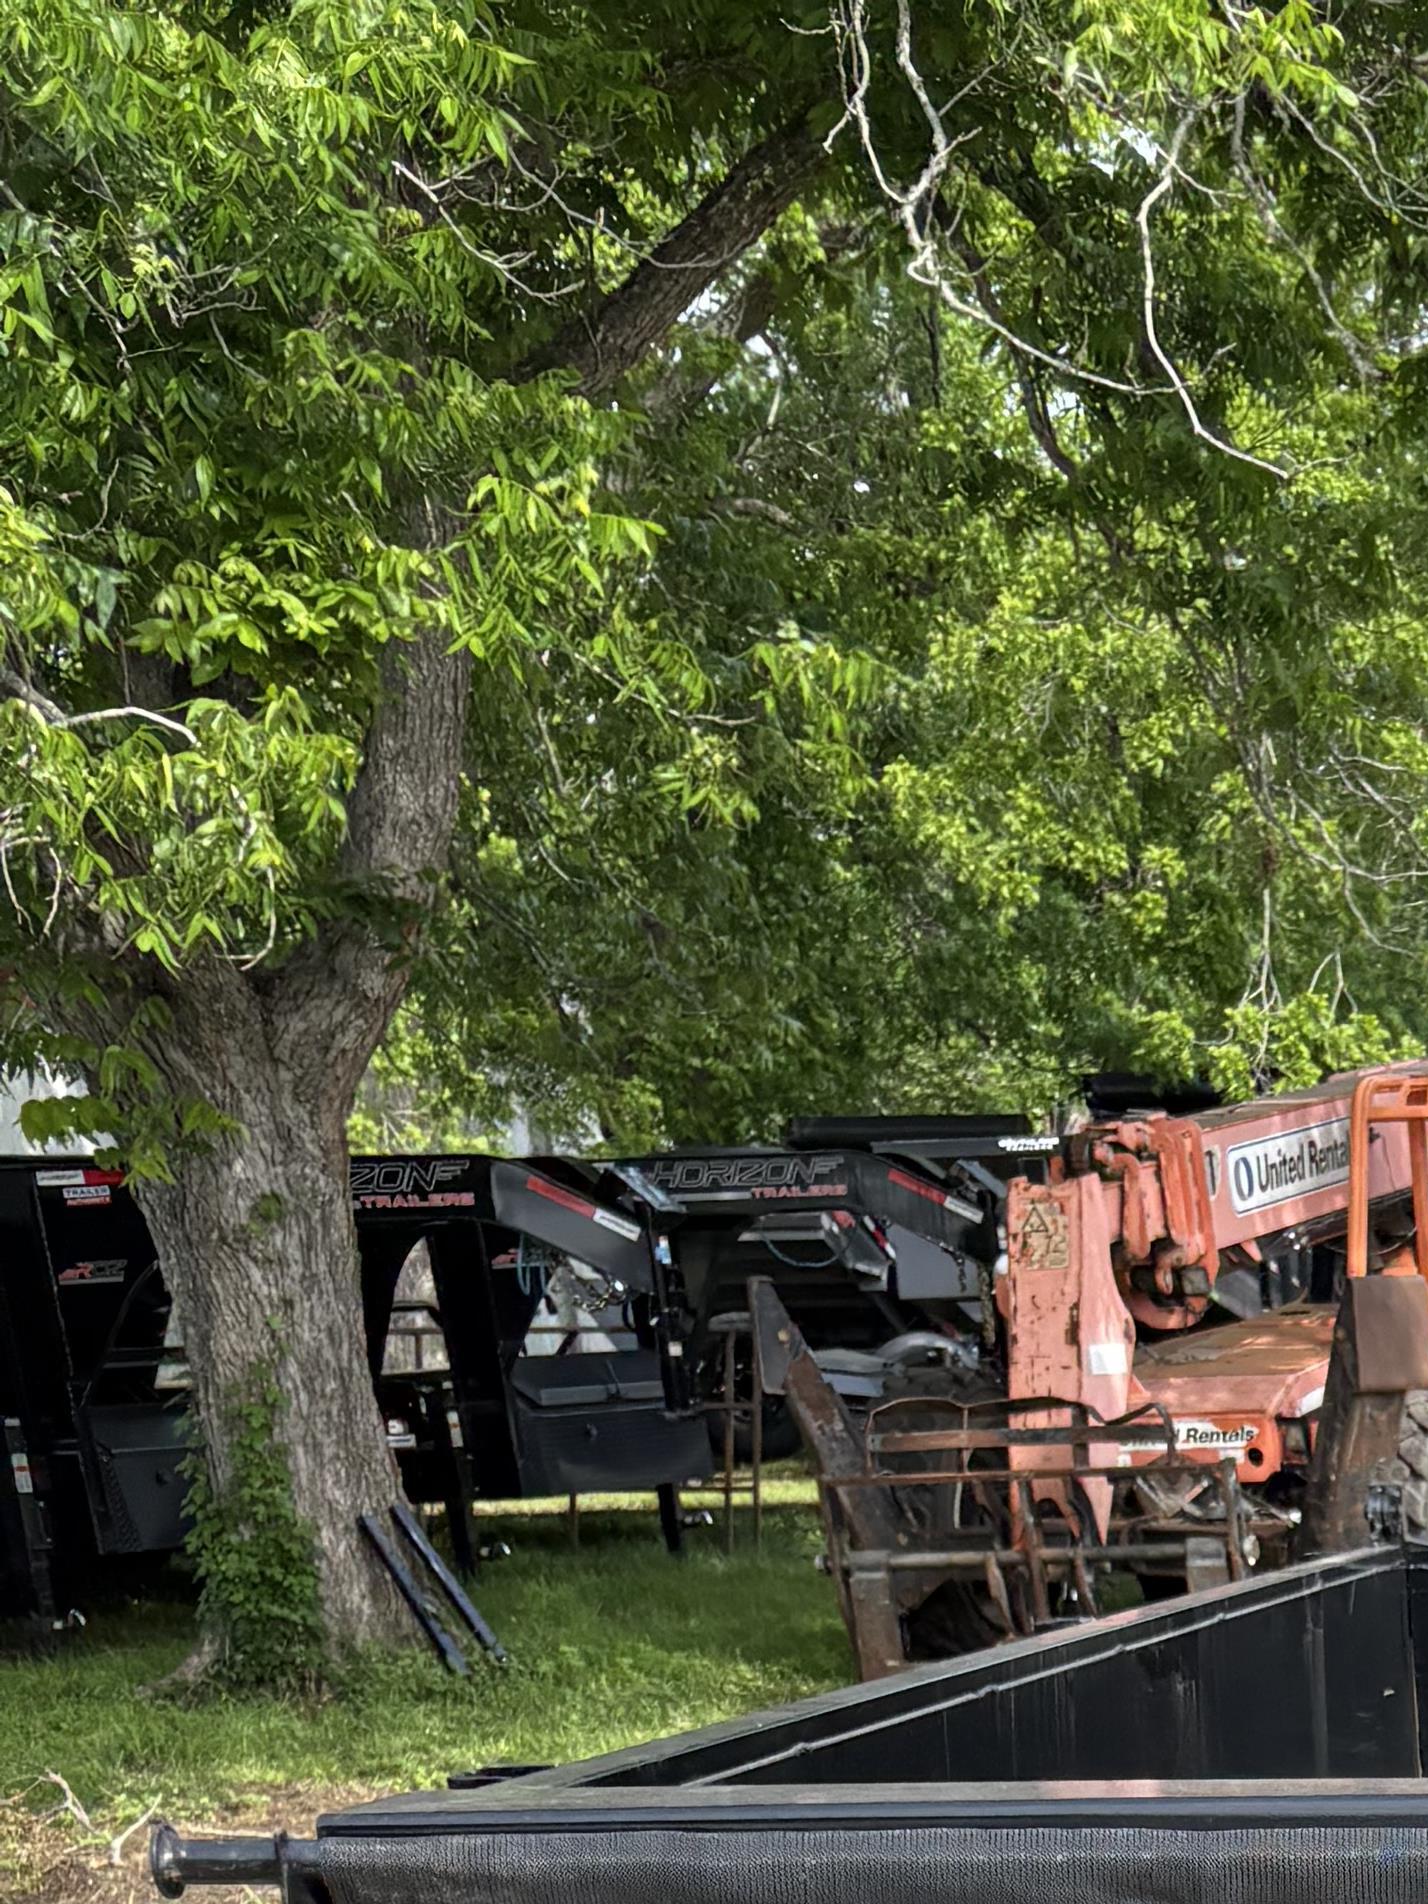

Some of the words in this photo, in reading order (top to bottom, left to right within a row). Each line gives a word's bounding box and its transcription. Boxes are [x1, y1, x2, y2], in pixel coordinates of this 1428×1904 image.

[1257, 1141, 1306, 1193] United
[1308, 1129, 1351, 1178] Rental
[653, 1157, 843, 1188] HORIZON
[360, 1193, 475, 1208] TRAILERS
[752, 1185, 848, 1199] TRAILERS
[1185, 1424, 1254, 1444] Rentals
